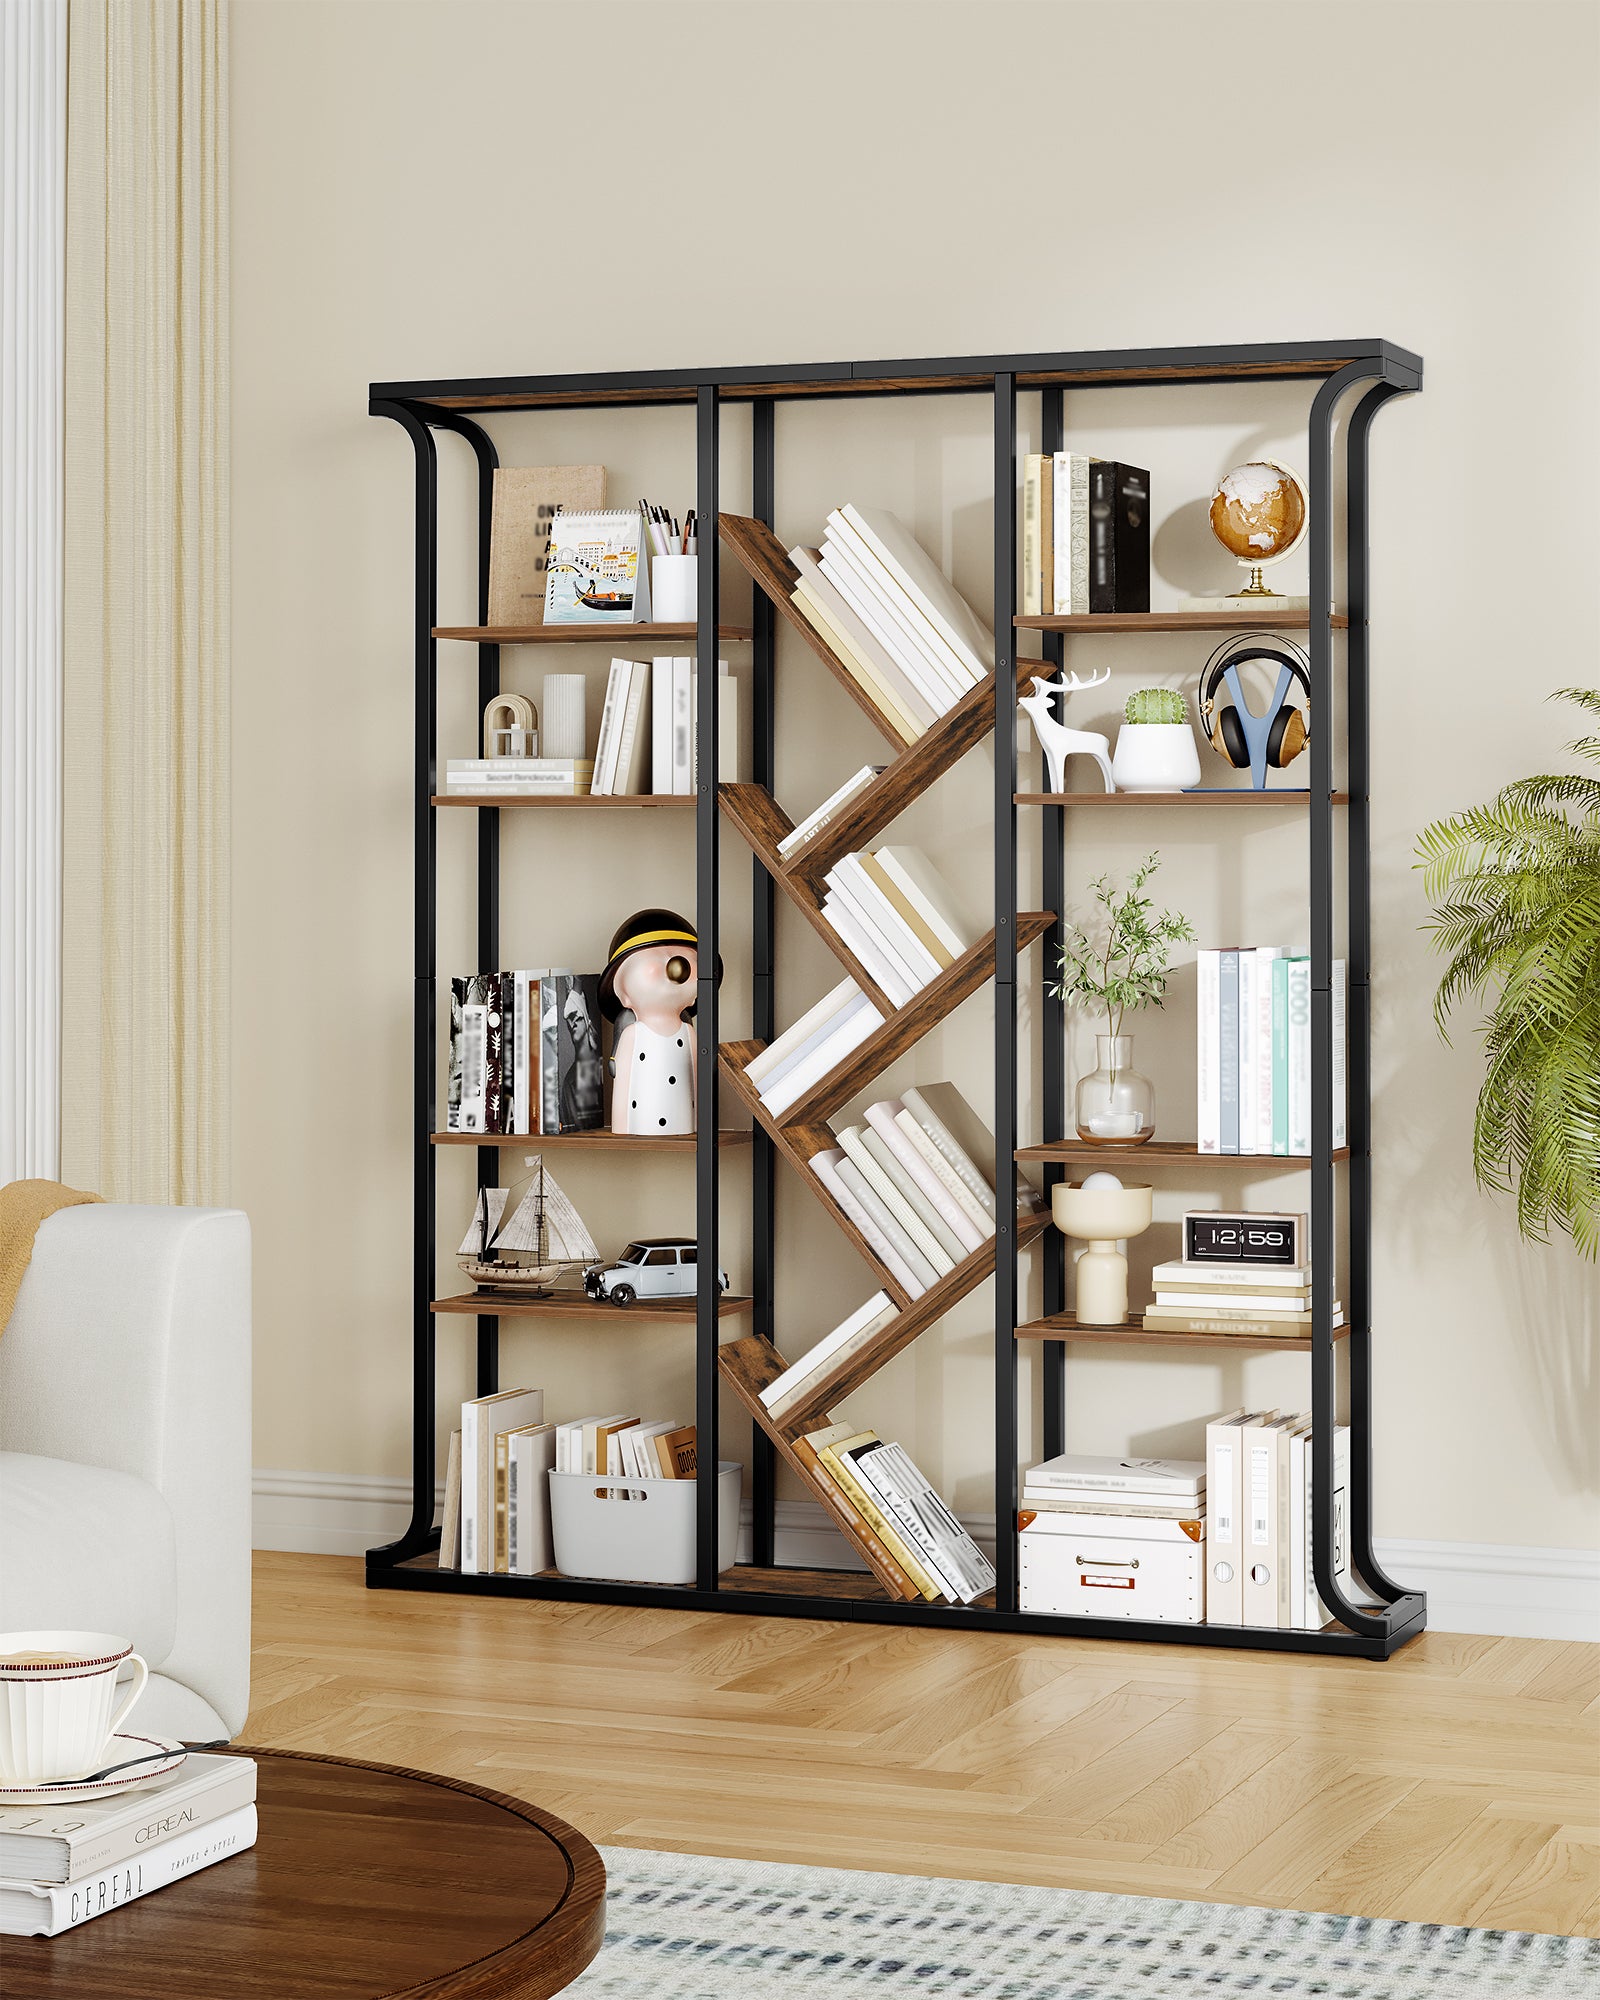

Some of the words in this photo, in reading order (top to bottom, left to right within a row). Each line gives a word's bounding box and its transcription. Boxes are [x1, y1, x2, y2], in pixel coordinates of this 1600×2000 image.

[134, 1807, 201, 1845] CEREAL
[171, 1852, 200, 1871] TRAVEL
[212, 1834, 237, 1853] STYLE
[71, 1864, 144, 1924] CEREAL
